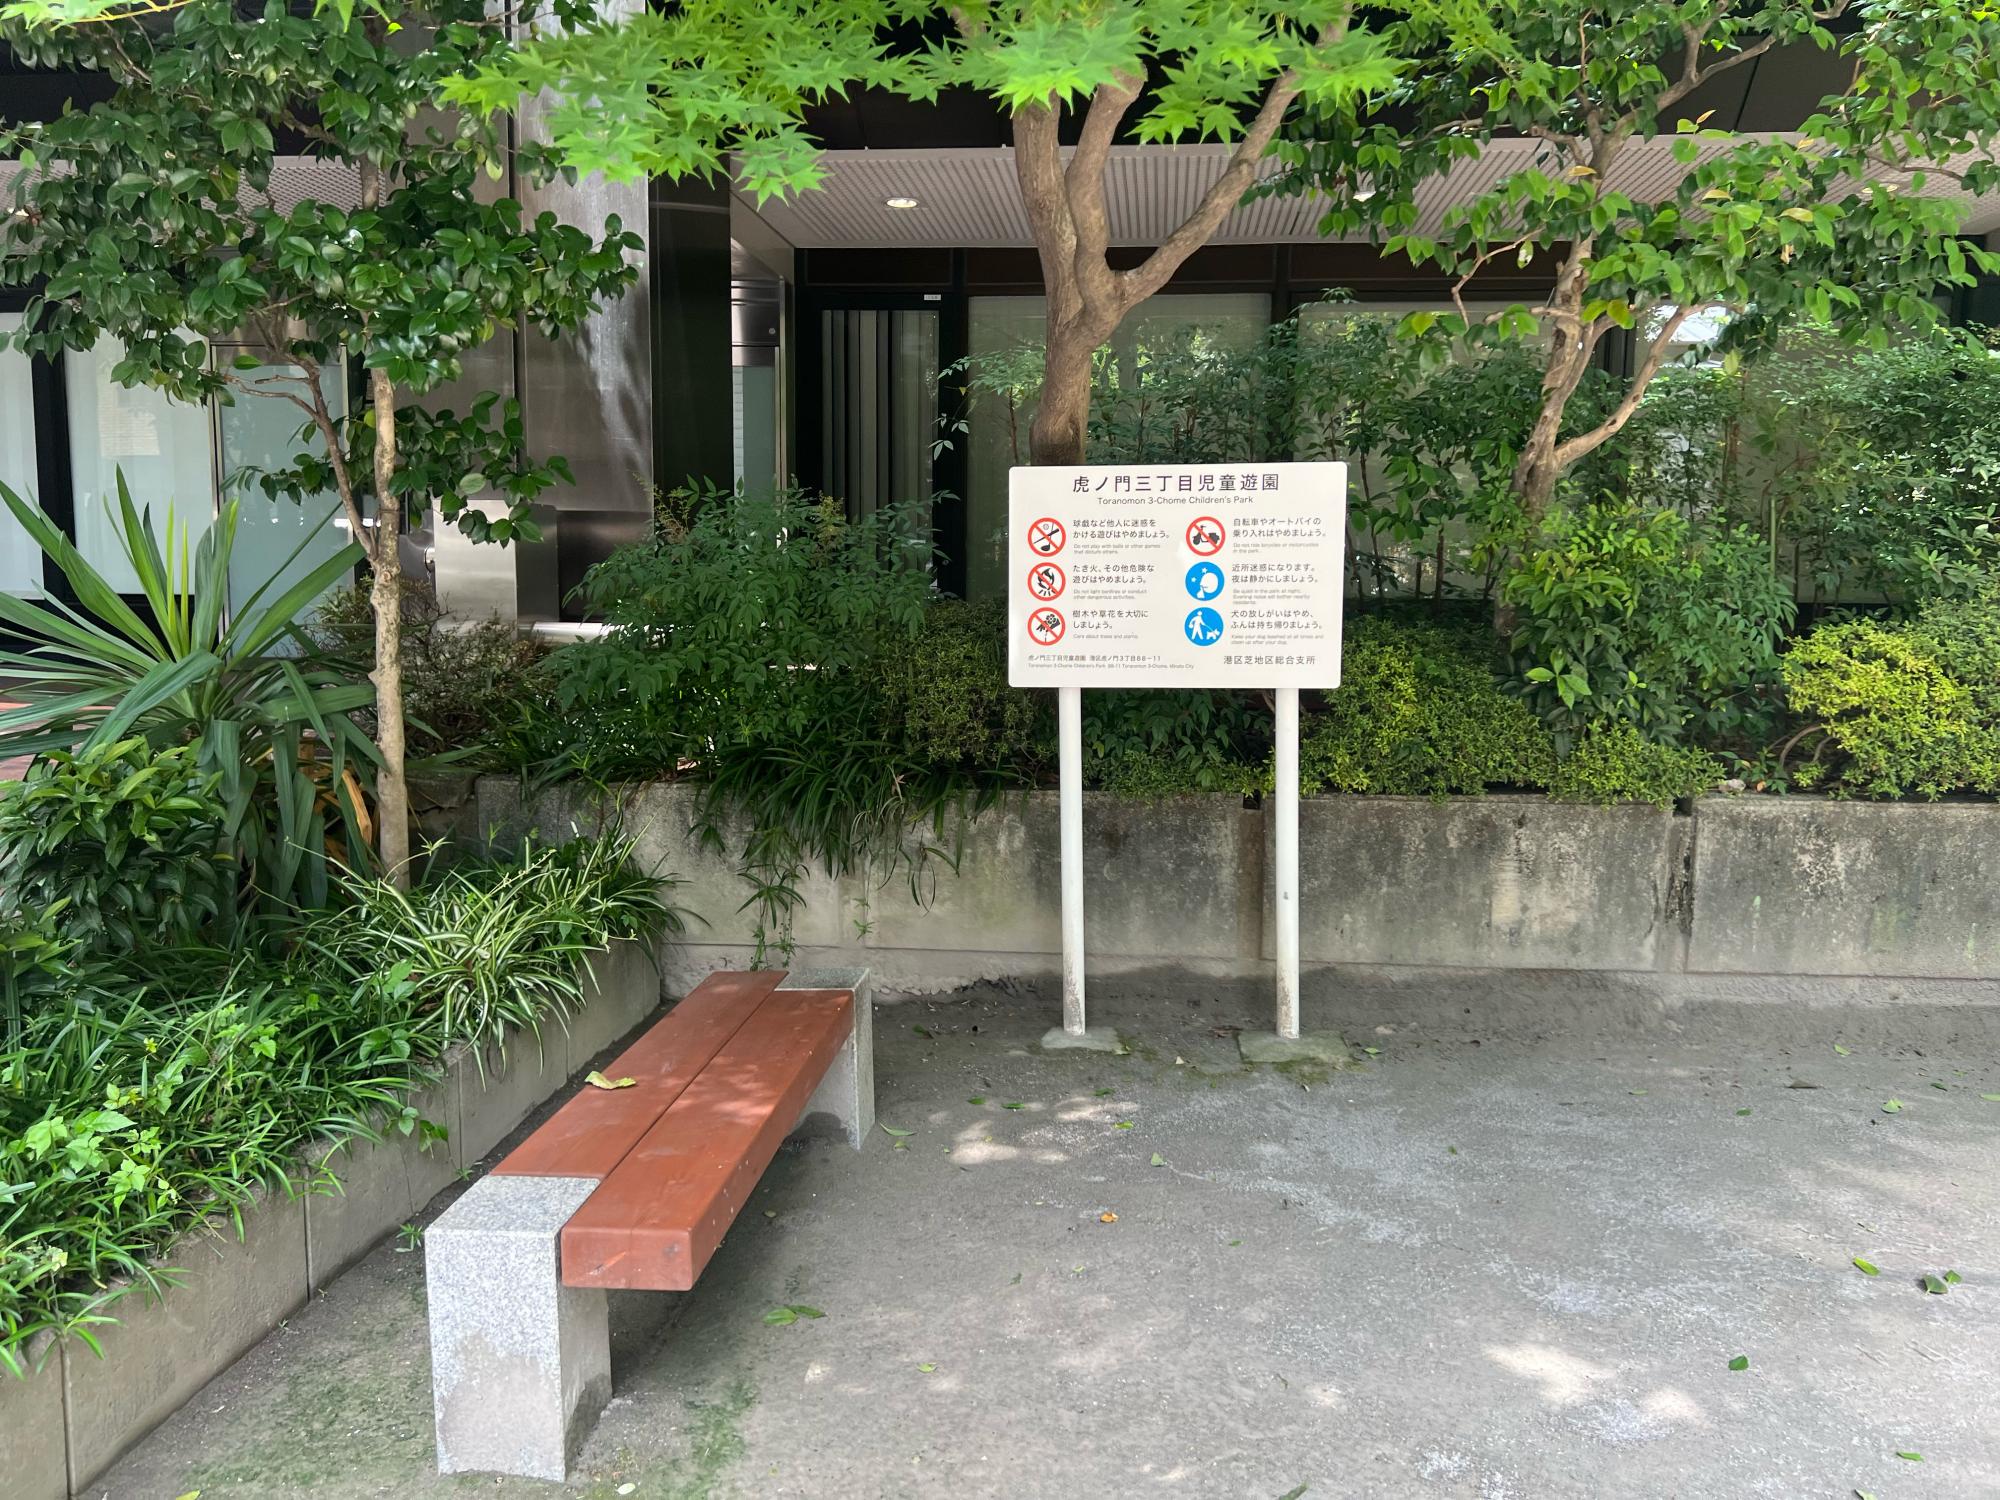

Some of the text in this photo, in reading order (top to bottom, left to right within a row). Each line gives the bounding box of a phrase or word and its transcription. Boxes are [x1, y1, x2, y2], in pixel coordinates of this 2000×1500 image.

[1073, 474, 1278, 492] 虎ノ門三丁目児童遊園
[1189, 496, 1231, 504] Children's
[1233, 517, 1322, 526] 自転車やオートバイの
[1073, 530, 1170, 538] かける遊びはやめましょう。
[1232, 529, 1326, 537] 乗り入れはやめましょう。
[1073, 564, 1155, 572] たき火、その他危険な
[1232, 564, 1315, 572] 近所迷惑になります。
[1073, 576, 1146, 584] 遊びはやめましょう。
[1232, 575, 1318, 583] 夜は静かにしましょう。
[1073, 621, 1112, 629] しましょう。
[1231, 621, 1322, 629] ふんは持ち帰りましょう。
[1224, 656, 1315, 664] 港区芝地区総合支所
